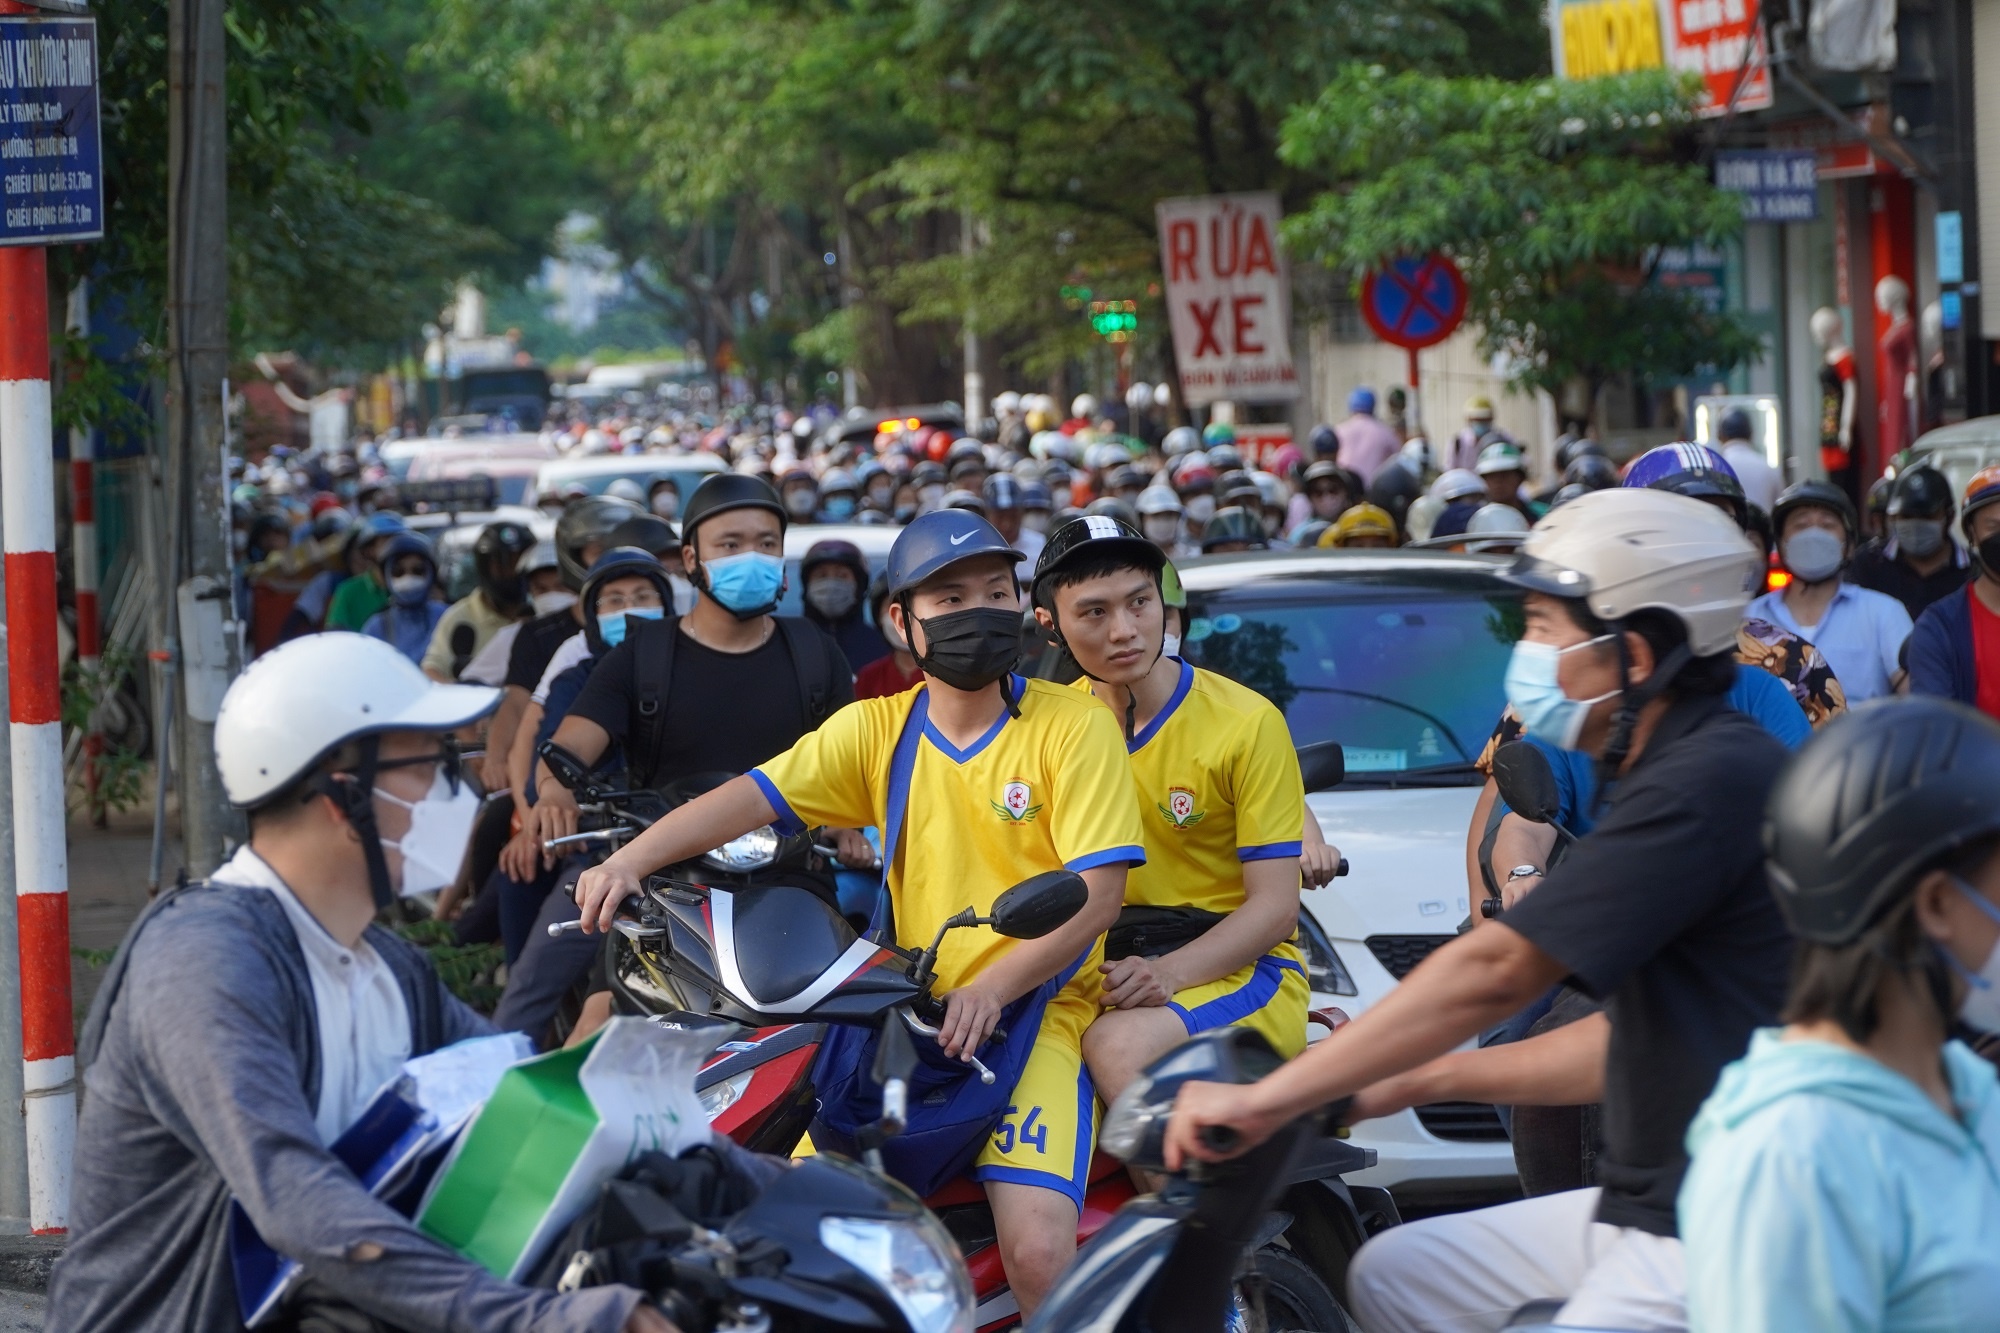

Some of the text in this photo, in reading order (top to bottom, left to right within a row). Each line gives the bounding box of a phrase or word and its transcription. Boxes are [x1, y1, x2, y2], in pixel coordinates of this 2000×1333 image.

[16, 33, 68, 88] KHƯƠNG
[68, 27, 92, 87] ĐÌNH
[5, 165, 31, 194] CHIỀU
[6, 199, 31, 228] CHIỀU
[1168, 200, 1278, 283] RỬA
[1187, 295, 1266, 359] XE
[923, 1097, 947, 1105] Reebok
[994, 1104, 1048, 1155] 54
